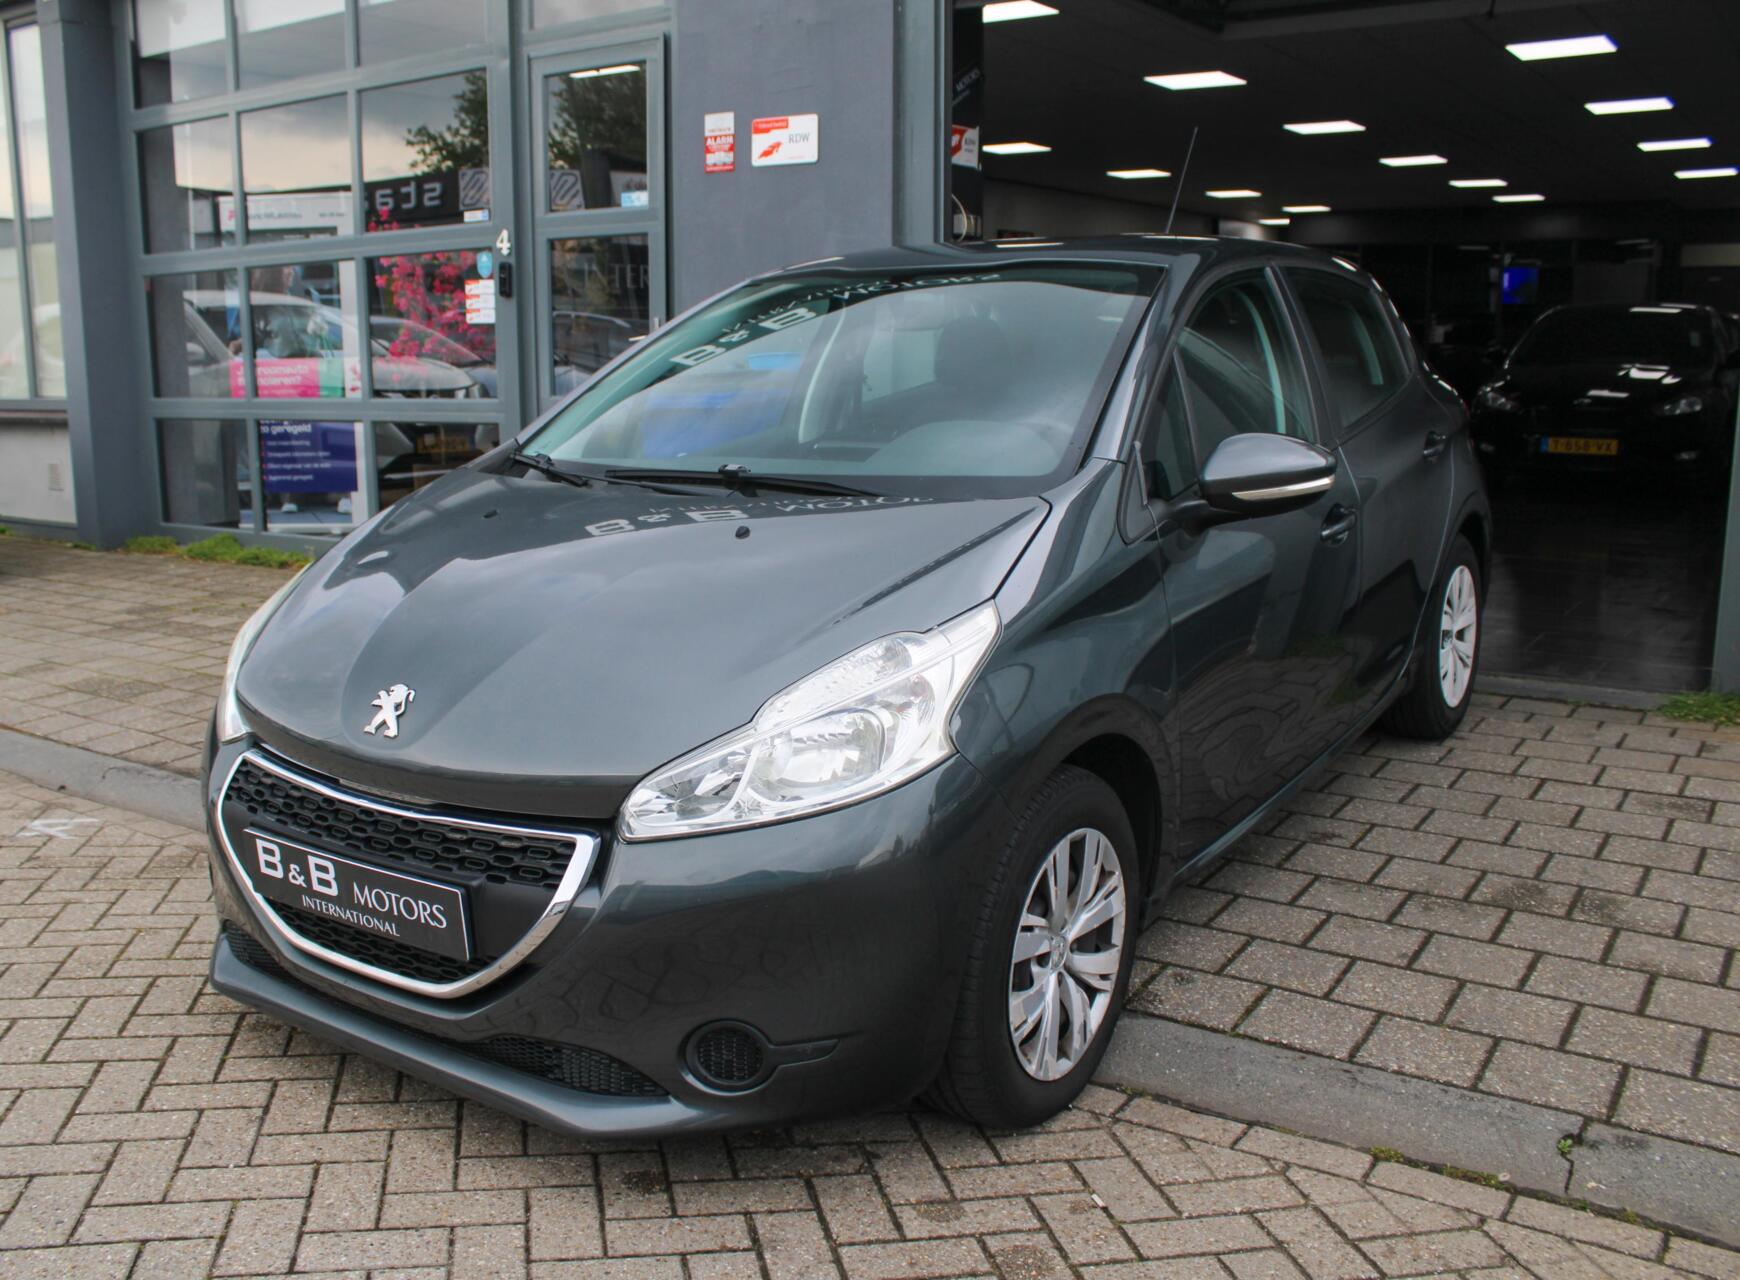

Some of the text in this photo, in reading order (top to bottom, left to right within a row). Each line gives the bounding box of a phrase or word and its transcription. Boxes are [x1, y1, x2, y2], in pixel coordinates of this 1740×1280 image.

[788, 132, 810, 144] RDW
[496, 228, 512, 256] 4
[302, 894, 401, 937] INTERNATIONAL
[353, 881, 447, 929] MOTORS
